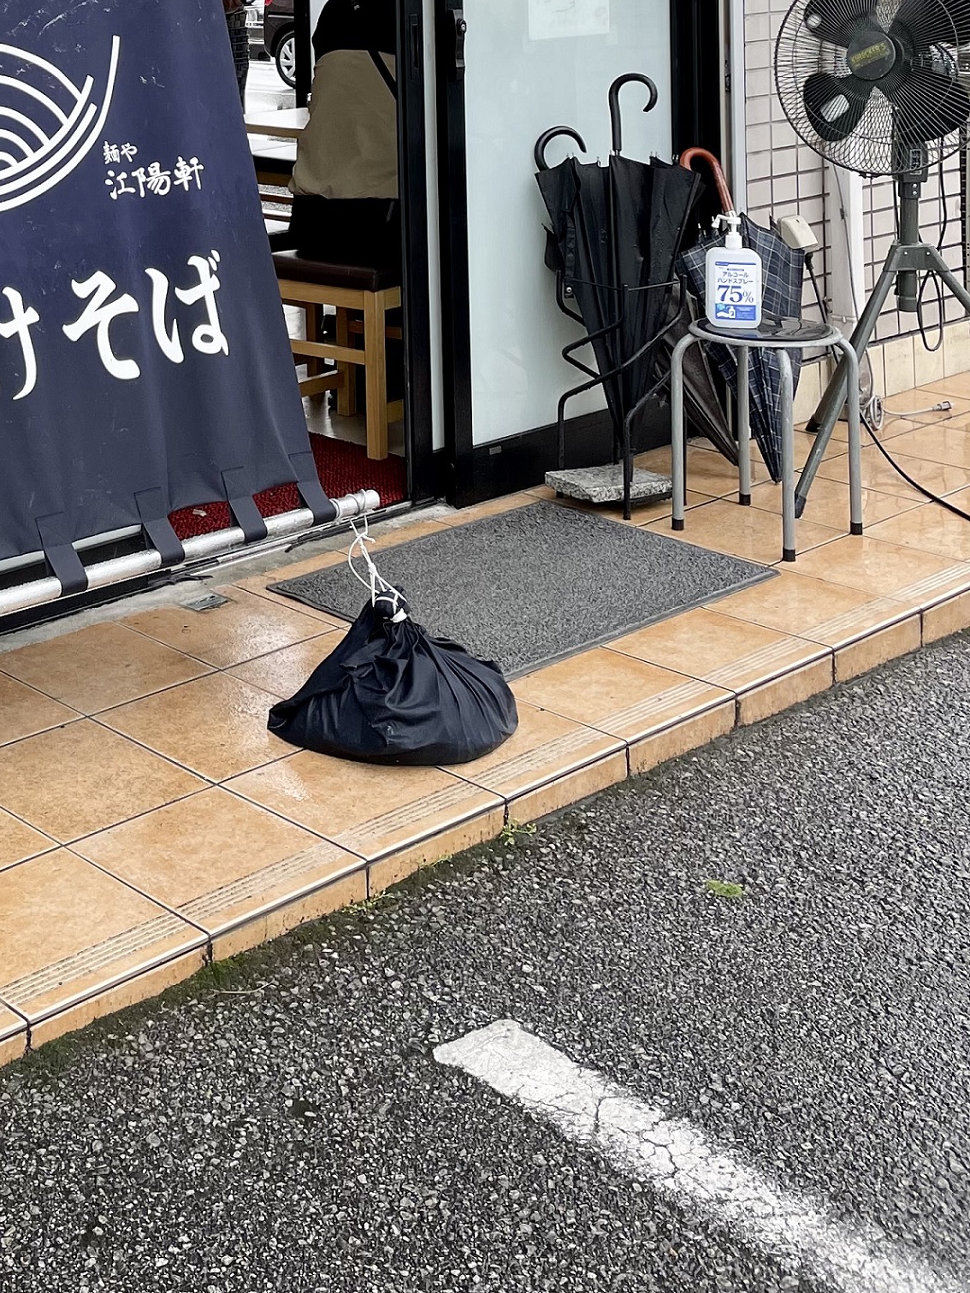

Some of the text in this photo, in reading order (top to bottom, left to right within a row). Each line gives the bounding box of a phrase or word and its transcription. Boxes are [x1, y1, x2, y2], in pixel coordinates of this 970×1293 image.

[103, 141, 137, 164] 麺や
[105, 156, 204, 200] 江陽軒
[717, 285, 754, 303] 75%
